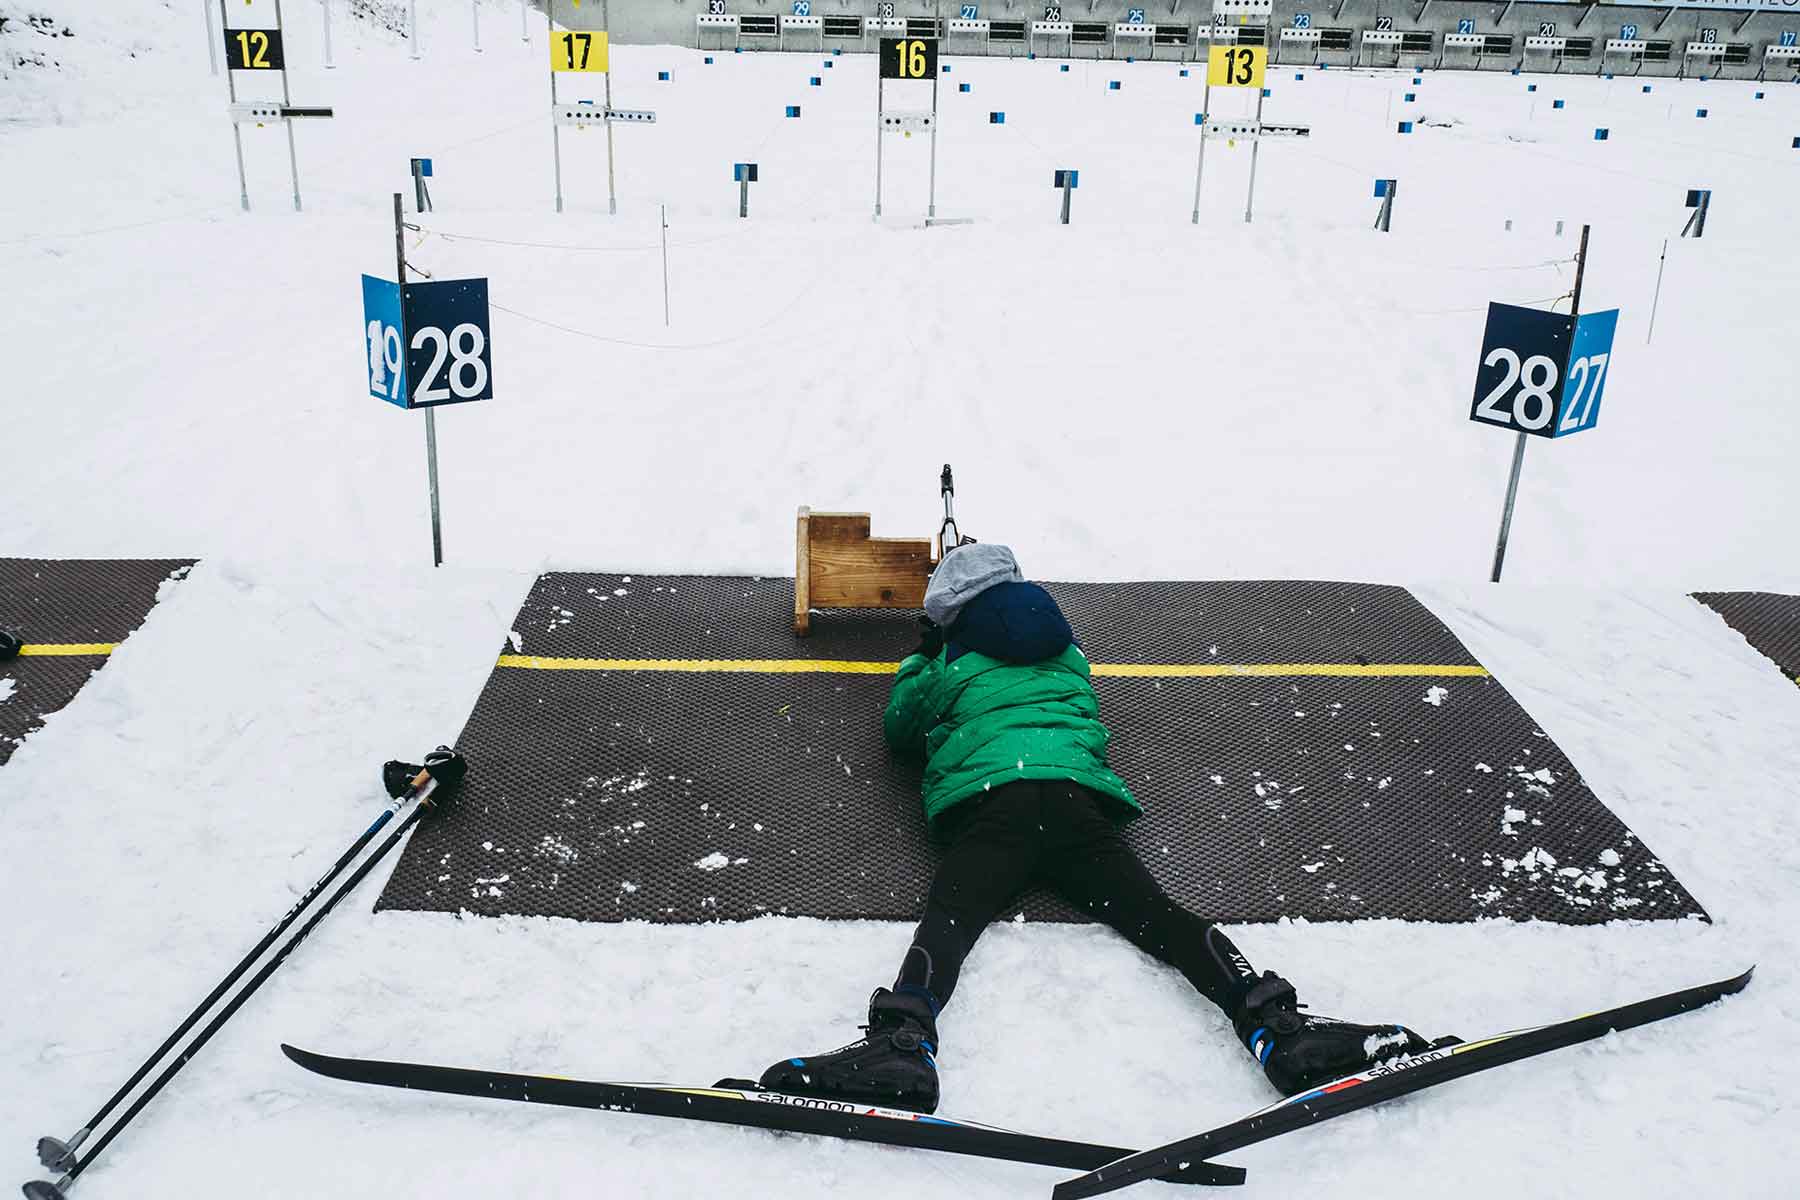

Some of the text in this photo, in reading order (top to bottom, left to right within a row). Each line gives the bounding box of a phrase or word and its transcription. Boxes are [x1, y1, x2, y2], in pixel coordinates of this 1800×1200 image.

[710, 1, 725, 13] 30
[794, 2, 809, 15] 29
[962, 5, 976, 19] 27
[1046, 8, 1061, 20] 26
[1129, 10, 1143, 24] 25
[1295, 14, 1310, 27] 23
[1377, 17, 1391, 31] 22
[1460, 20, 1474, 34] 21
[1540, 23, 1555, 37] 20
[1622, 26, 1635, 39] 19
[1703, 29, 1716, 43] 18
[1783, 32, 1795, 46] 17
[236, 31, 271, 68] 12
[562, 33, 592, 69] 17
[895, 40, 926, 77] 16
[1225, 49, 1254, 85] 13
[411, 323, 488, 403] 28
[1476, 348, 1558, 430] 28
[1559, 353, 1609, 431] 27
